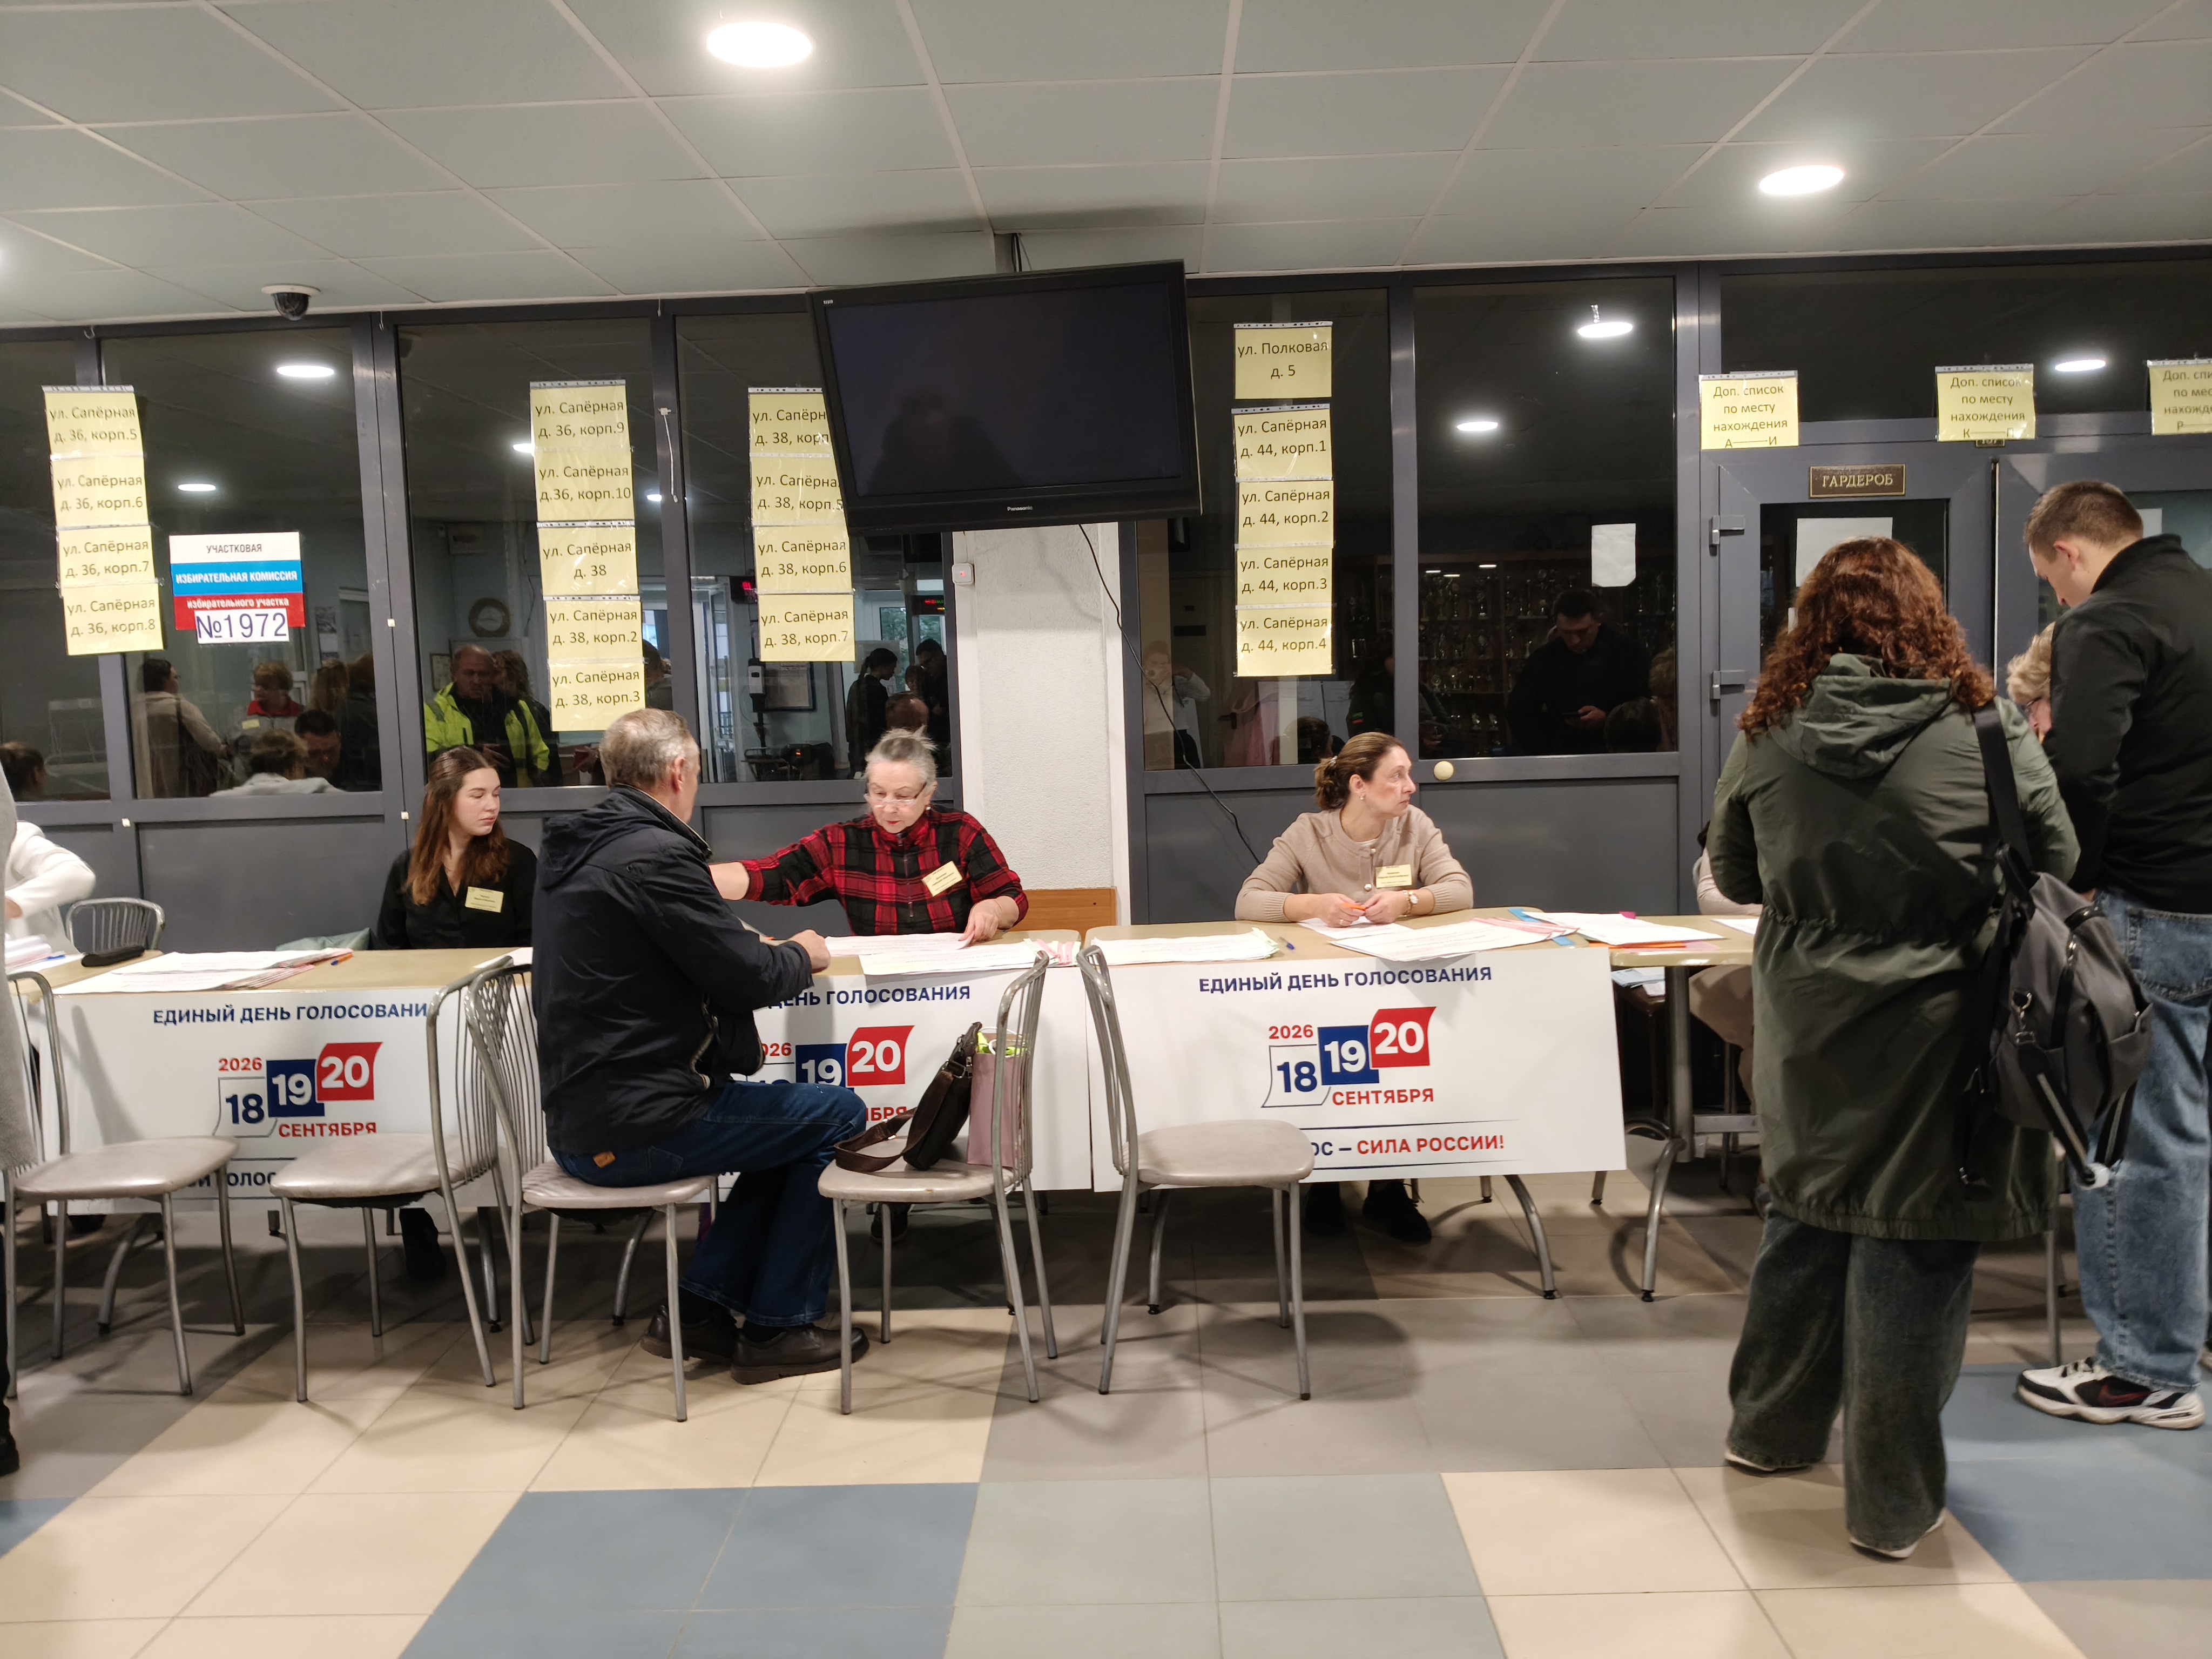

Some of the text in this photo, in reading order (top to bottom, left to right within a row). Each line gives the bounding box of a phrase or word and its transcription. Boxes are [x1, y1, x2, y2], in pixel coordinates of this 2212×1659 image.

[1238, 341, 1328, 358] ул. Полковая
[1270, 365, 1296, 380] д. 5
[2162, 370, 2212, 382] Доп. спи
[1744, 386, 1784, 395] список
[1950, 377, 2021, 389] Доп. список
[1961, 396, 2013, 406] по месту
[50, 406, 135, 421] ул. Сапёрная
[535, 401, 623, 417] ул. Сапёрная
[753, 408, 826, 424] ул. Сапёрн
[1724, 404, 1775, 414] по месту
[2164, 405, 2212, 415] нахожд
[1951, 413, 2025, 422] нахождения
[538, 422, 624, 439] д. 36, корп.9
[1238, 419, 1326, 436] ул. Сапёрная
[1714, 420, 1788, 432] нахождения
[54, 429, 137, 444] д. 36, корп.5
[755, 432, 829, 446] д. 38, корп
[1240, 441, 1326, 459] д. 44, корп.1
[539, 466, 629, 480] ул. Сапёрная
[57, 475, 142, 489] ул. Сапёрная
[756, 474, 839, 490] ул. Сапёрна
[1823, 474, 1893, 488] ГАРДЕРОБ
[578, 487, 631, 501] корп.10
[1242, 489, 1330, 505] ул. Сапёрная
[60, 497, 143, 512] д. 36, корп.6
[757, 499, 770, 510] д.
[775, 497, 794, 510] 38,
[1243, 511, 1328, 528] д. 44, корп.2
[63, 541, 149, 556] ул. Сапёрная
[206, 544, 262, 554] УЧАСТКОВАЯ
[543, 542, 631, 557] ул. Сапёрная
[758, 540, 846, 555] ул. Сапёрная
[66, 561, 149, 579] д. 36, корп.7
[574, 565, 606, 579] д. 38
[761, 561, 846, 577] д. 38, корп.6
[1241, 557, 1328, 572] ул. Сапёрная
[175, 571, 297, 584] ИЗБИРАТЕЛЬНАЯ КОМИССИЯ
[1242, 578, 1327, 594] д. 44, корп.3
[67, 599, 154, 616] ул. Сапёрная
[187, 597, 289, 609] избирательного участка
[550, 610, 637, 624] ул. Сапёрная
[761, 610, 848, 625] ул. Сапёрная
[1240, 617, 1327, 632] ул. Сапёрная
[71, 619, 156, 637] д. 36, корп.8
[553, 631, 637, 645] д. 38, корп.2
[765, 630, 848, 647] д. 38, корп.7
[1242, 638, 1326, 653] д. 44, корп.4
[552, 671, 639, 686] ул. Сапёрная
[556, 691, 640, 709] д. 38, корп.3
[1199, 967, 1492, 994] ЕДИНЫЙ ДЕНЬ ГОЛОСОВАНИЯ
[826, 986, 970, 1005] ГОЛОСОВАНИЯ
[153, 1002, 440, 1026] ЕДИНЫЙ ДЕНЬ ГОЛОСОВАНИ
[1268, 1024, 1313, 1040] 2026
[1373, 1021, 1425, 1054] 20
[761, 1042, 792, 1057] 026
[851, 1038, 901, 1073] 20
[1324, 1039, 1367, 1073] 19
[218, 1056, 262, 1071] 2026
[801, 1057, 843, 1085] 19
[320, 1055, 370, 1089] 20
[1277, 1061, 1318, 1093] 18
[271, 1073, 313, 1107] 19
[1332, 1088, 1434, 1106] СЕНТЯБРЯ
[226, 1093, 265, 1124] 18
[279, 1122, 377, 1138] СЕНТЯБРЯ
[1357, 1138, 1411, 1155] СИЛА
[1417, 1135, 1504, 1152] РОССИИ!
